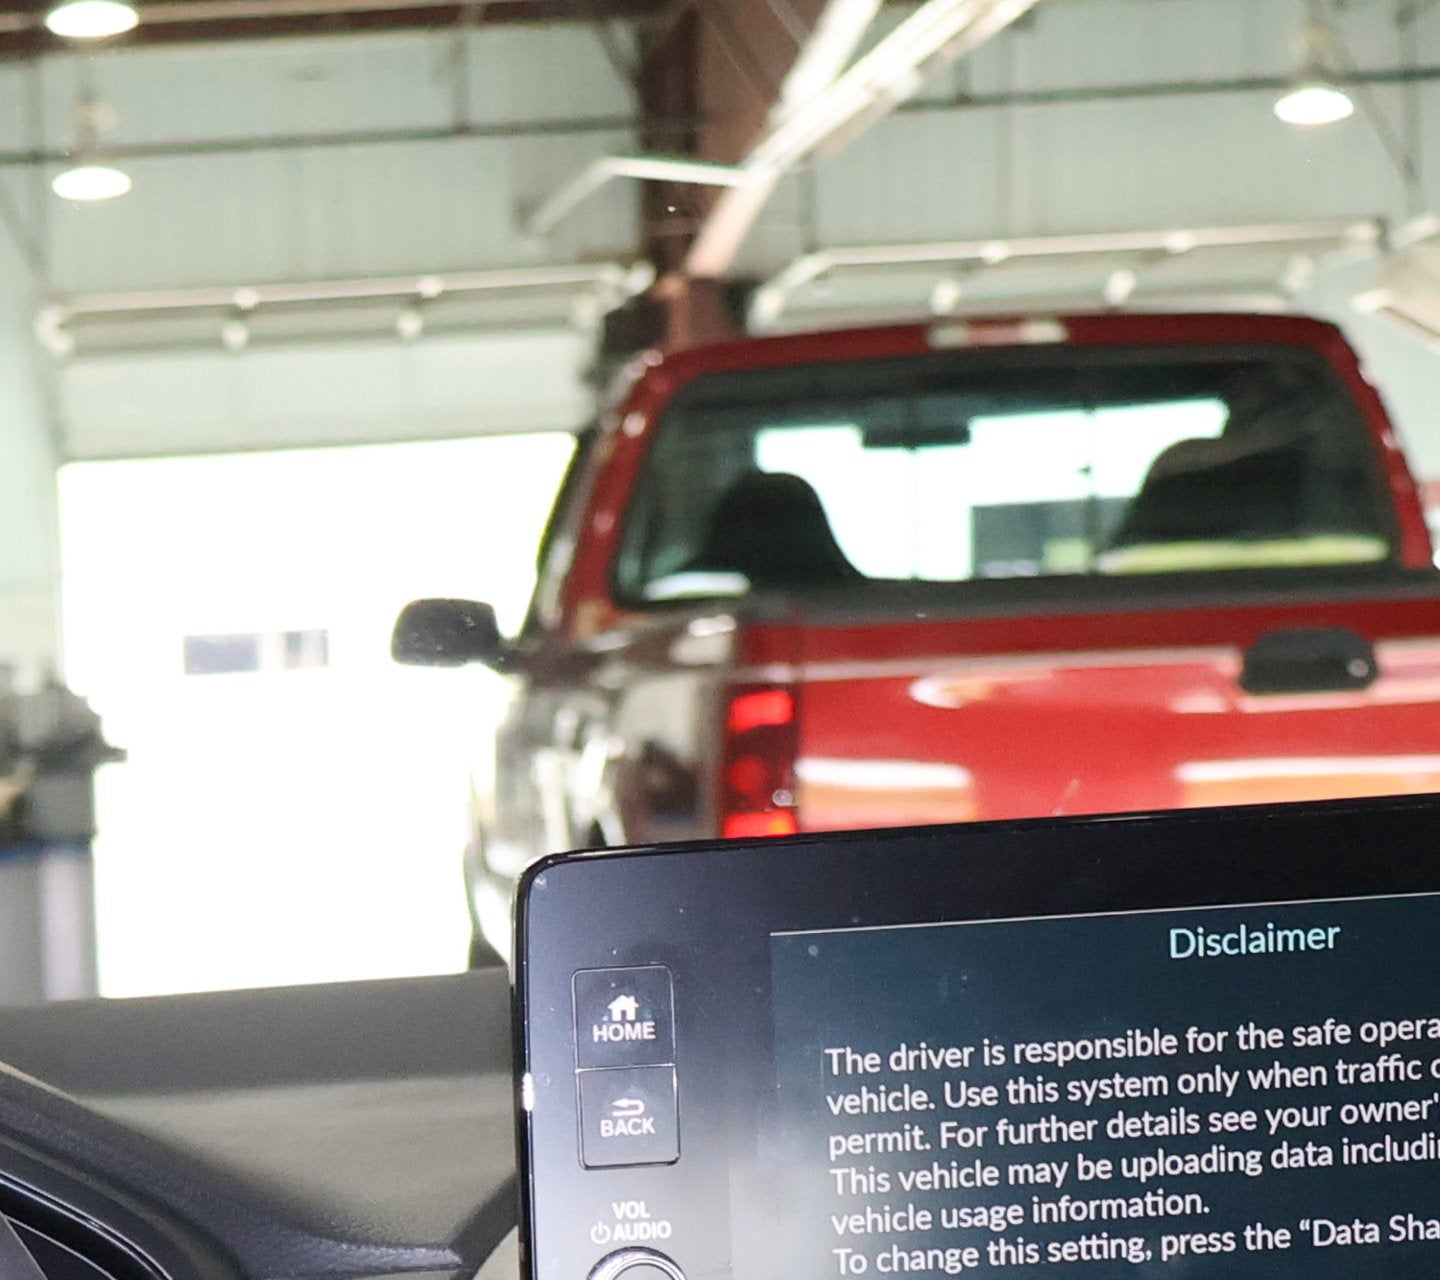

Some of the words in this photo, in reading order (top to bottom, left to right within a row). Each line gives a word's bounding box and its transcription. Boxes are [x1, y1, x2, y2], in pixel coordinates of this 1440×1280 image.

[1170, 922, 1341, 958] Disclaimer
[592, 1021, 657, 1043] HOME
[824, 1046, 881, 1075] The
[889, 1042, 975, 1071] driver
[983, 1038, 1006, 1066] is
[1014, 1027, 1178, 1067] responsible
[1185, 1026, 1228, 1053] for
[1236, 1022, 1284, 1050] the
[1292, 1018, 1352, 1047] safe
[826, 1084, 935, 1115] vehicle.
[944, 1080, 998, 1108] Use
[1006, 1075, 1059, 1104] this
[1067, 1073, 1168, 1106] system
[1177, 1064, 1240, 1097] only
[1247, 1061, 1327, 1090] when
[1335, 1053, 1422, 1084] traffic
[600, 1116, 657, 1138] BACK
[830, 1124, 931, 1161] permit.
[940, 1121, 988, 1149] For
[996, 1114, 1099, 1145] further
[1106, 1107, 1200, 1139] details
[1208, 1110, 1257, 1133] see
[1264, 1105, 1332, 1135] your
[830, 1166, 890, 1194] This
[898, 1159, 999, 1191] vehicle
[1008, 1161, 1069, 1188] may
[1077, 1153, 1113, 1180] be
[1121, 1145, 1263, 1183] uploading
[1271, 1141, 1333, 1169] data
[611, 1200, 652, 1220] VOL
[612, 1220, 673, 1242] AUDIO
[832, 1203, 932, 1234] vehicle
[941, 1204, 1024, 1231] usage
[1032, 1188, 1210, 1223] information.
[833, 1249, 867, 1274] To
[877, 1245, 979, 1274] change
[987, 1237, 1040, 1266] this
[1047, 1232, 1152, 1263] setting,
[1161, 1231, 1236, 1262] press
[1243, 1222, 1291, 1250] the
